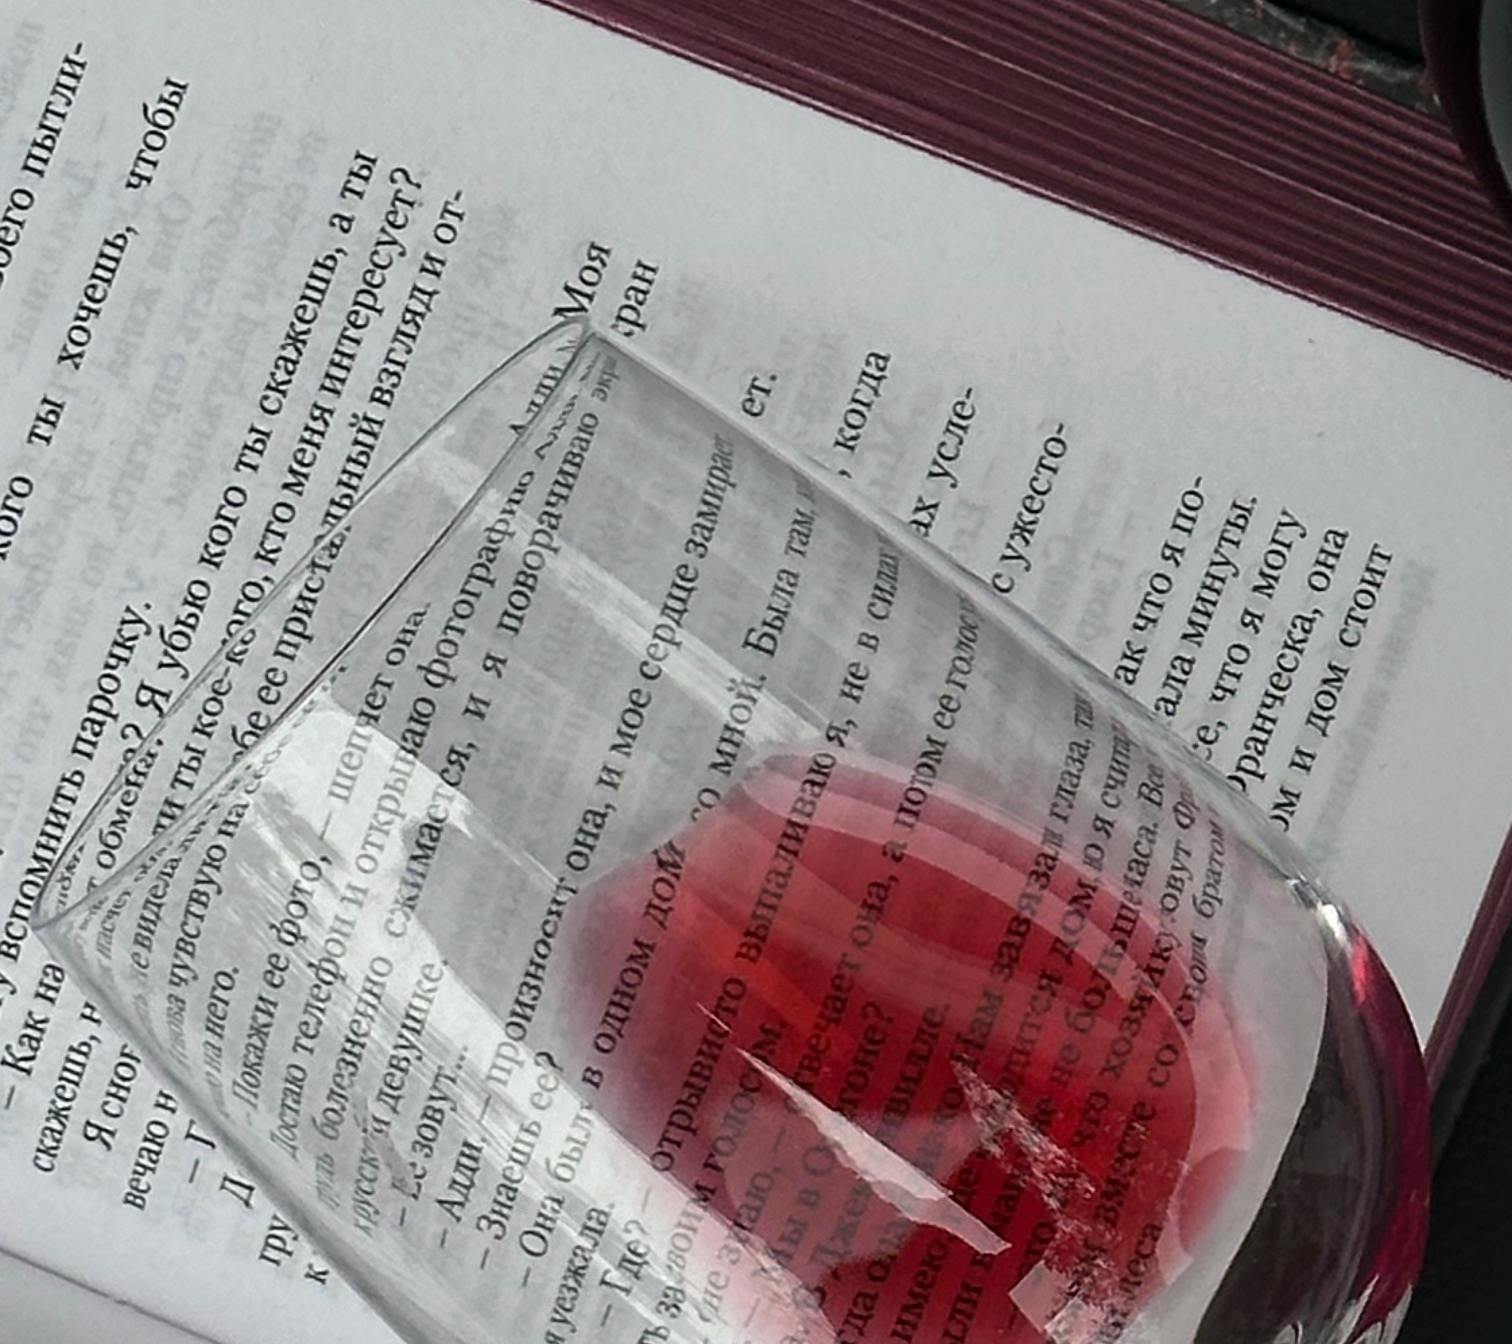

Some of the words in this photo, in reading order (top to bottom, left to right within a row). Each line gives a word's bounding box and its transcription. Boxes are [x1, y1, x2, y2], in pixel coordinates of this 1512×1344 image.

[19, 41, 88, 180] пытли-
[337, 148, 380, 202] ты
[432, 189, 467, 246] от-
[25, 393, 67, 447] ты
[56, 225, 140, 372] хочешь,
[123, 76, 190, 191] чтобы
[327, 211, 357, 236] а
[417, 250, 448, 281] и
[551, 240, 613, 325] Моя
[257, 246, 350, 420] скажешь,
[366, 281, 442, 411] взгляд
[831, 351, 892, 455] когда
[925, 386, 977, 491] усле-
[231, 421, 275, 476] ты
[195, 484, 249, 574] кого
[998, 421, 1069, 574] ужесто-
[1169, 475, 1206, 539] по-
[990, 571, 1016, 595] с
[1159, 538, 1188, 570] я
[1179, 496, 1259, 649] минуты.
[1250, 508, 1309, 601] могу
[1306, 528, 1350, 594] она
[155, 578, 213, 682] убью
[1130, 571, 1174, 633] что
[1239, 606, 1266, 637] я
[31, 1033, 103, 1174] скажешь,
[252, 500, 297, 568] кто
[279, 400, 337, 498] меня
[316, 166, 424, 400] интересует?
[69, 601, 154, 763] парочку.
[135, 678, 174, 717] Я
[1207, 642, 1252, 703] что
[1286, 744, 1318, 776] и
[1304, 659, 1352, 739] дом
[1337, 542, 1394, 650] стоит
[32, 962, 66, 1007] на
[1, 1009, 51, 1078] Как
[121, 1119, 171, 1212] вечаю
